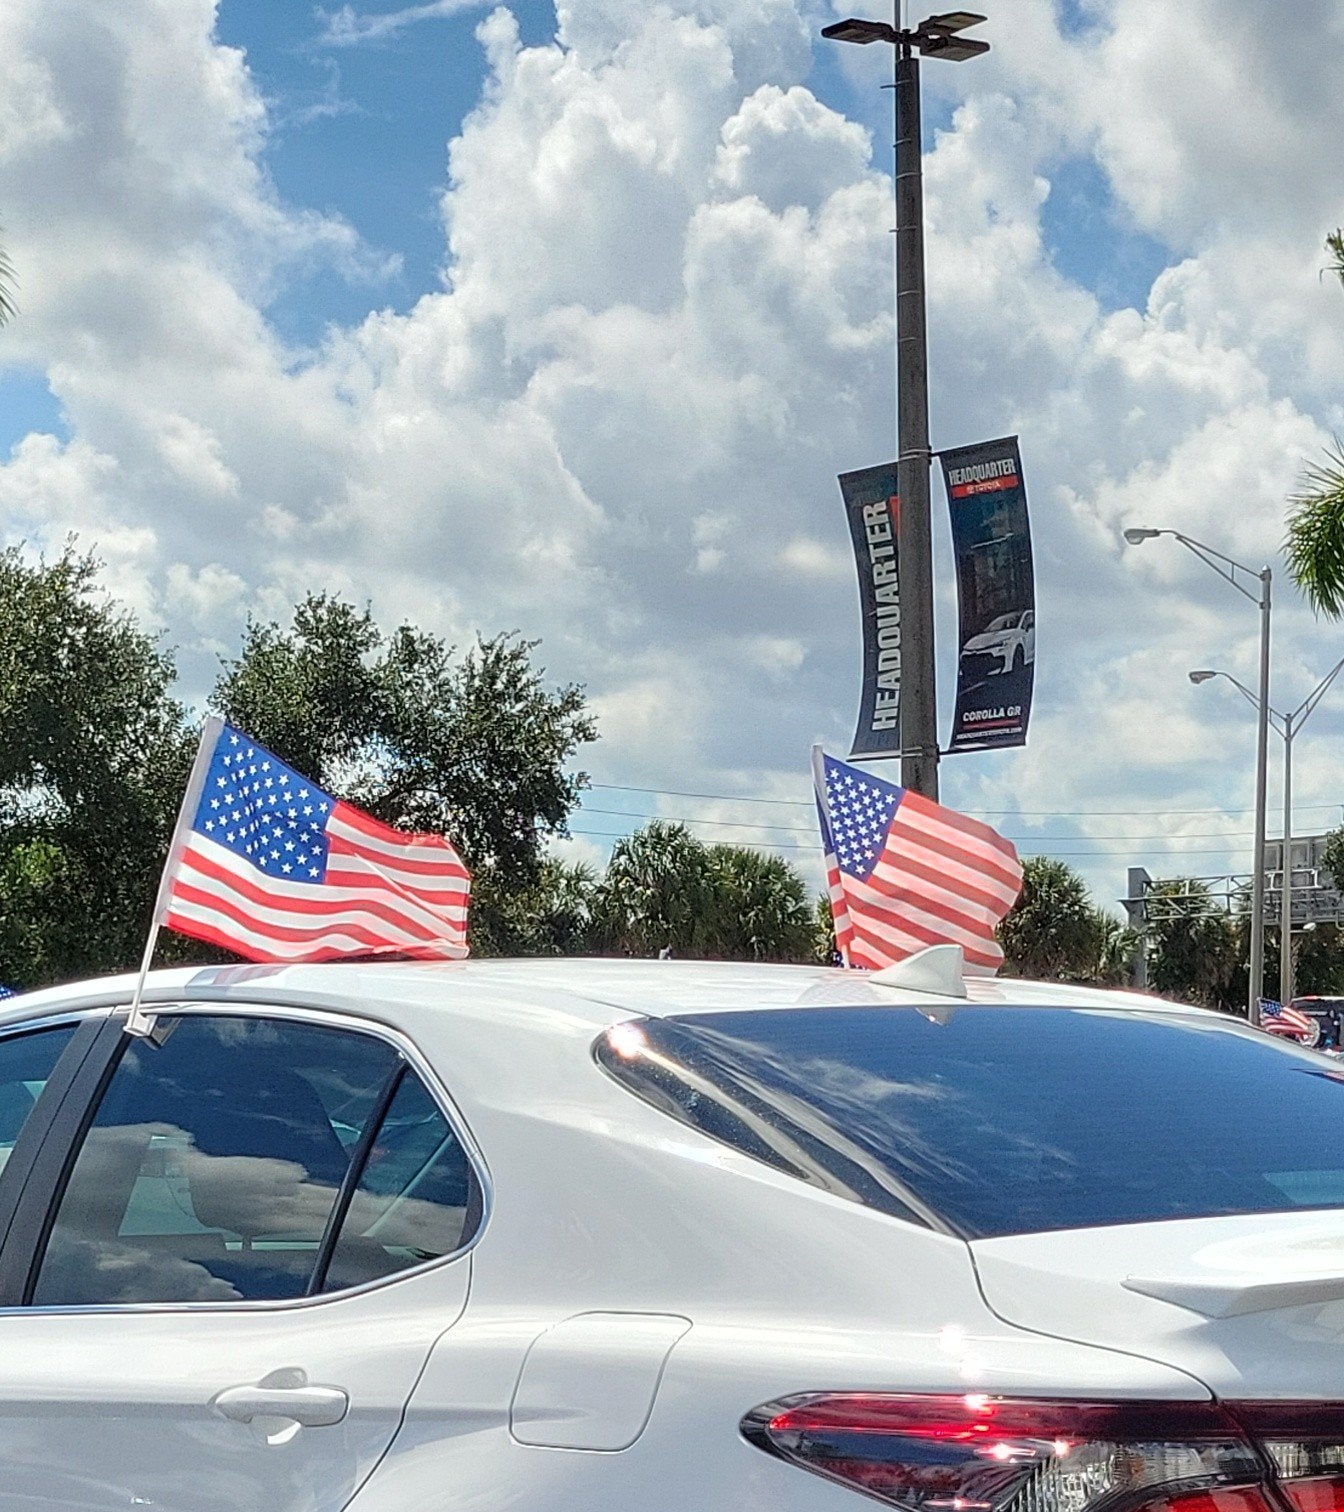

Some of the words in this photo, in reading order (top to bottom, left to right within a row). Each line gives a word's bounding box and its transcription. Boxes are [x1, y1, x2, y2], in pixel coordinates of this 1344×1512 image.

[948, 458, 1017, 486] HEADQUARTER
[863, 501, 901, 731] HEADQUARTER
[962, 707, 1005, 722] COROLLA
[1007, 705, 1022, 717] GR
